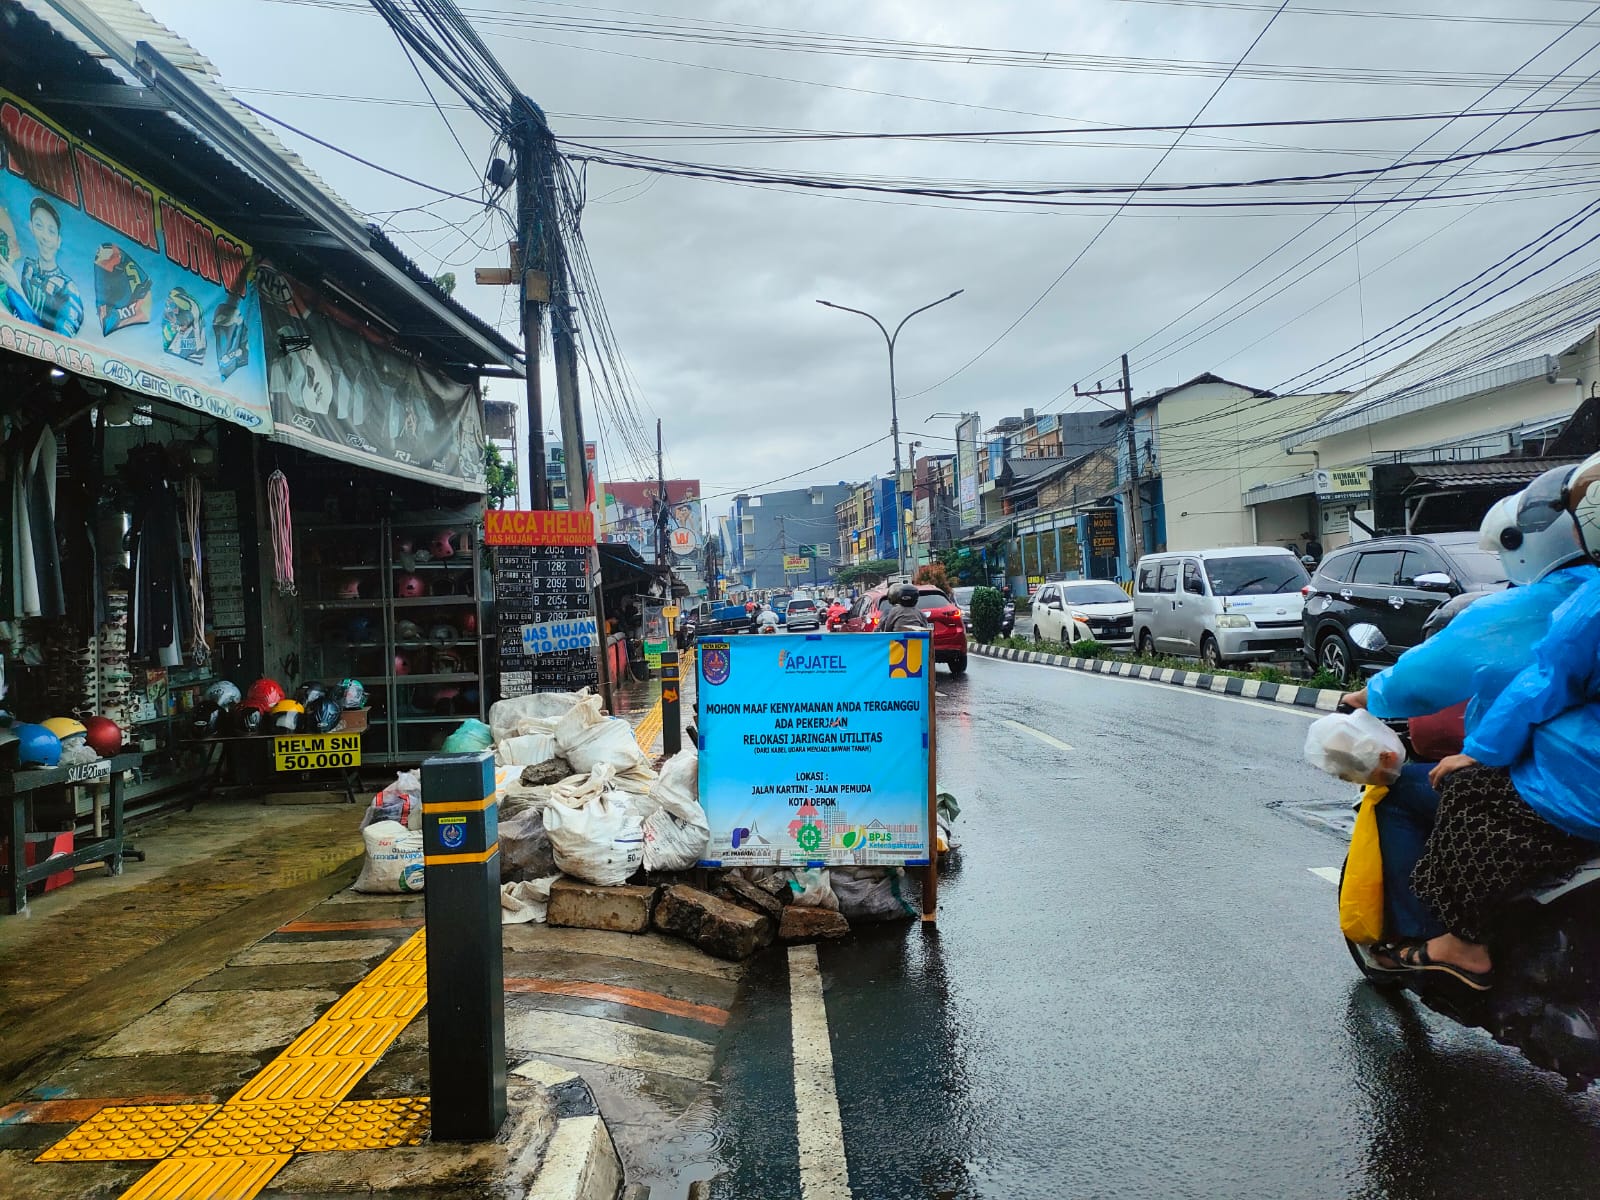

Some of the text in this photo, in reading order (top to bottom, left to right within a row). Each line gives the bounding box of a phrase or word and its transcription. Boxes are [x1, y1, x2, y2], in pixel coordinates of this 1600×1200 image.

[487, 512, 592, 534] KACA HELM
[489, 534, 503, 544] JAS
[505, 534, 533, 544] HUJAN
[541, 534, 561, 544] PLAT
[564, 535, 592, 544] NOMOR
[547, 561, 567, 572] 1282
[534, 578, 586, 588] B 2092 CD
[534, 595, 588, 606] B 2054 FD
[535, 612, 541, 622] B
[523, 620, 597, 642] JAS HUJAN
[531, 636, 591, 653] 10.000
[785, 655, 847, 670] APJATEL
[706, 700, 920, 714] MOHON MAAF KENYAMANAN ANDA TERGANGGU
[774, 717, 848, 729] ADA PEKERJAAN
[743, 732, 883, 745] RELOKASI JARINGAN UTILITAS
[277, 737, 358, 752] HELM SNI
[284, 753, 353, 770] 50.000
[68, 765, 87, 783] SALE
[796, 772, 824, 781] LOKASI
[751, 785, 775, 795] JALAN
[776, 785, 808, 794] KARTINI
[815, 785, 838, 794] JALAN
[840, 784, 872, 793] PEMUDA
[788, 797, 836, 807] KOTA DEPOK
[868, 832, 892, 842] BPJS
[627, 854, 636, 862] 50
